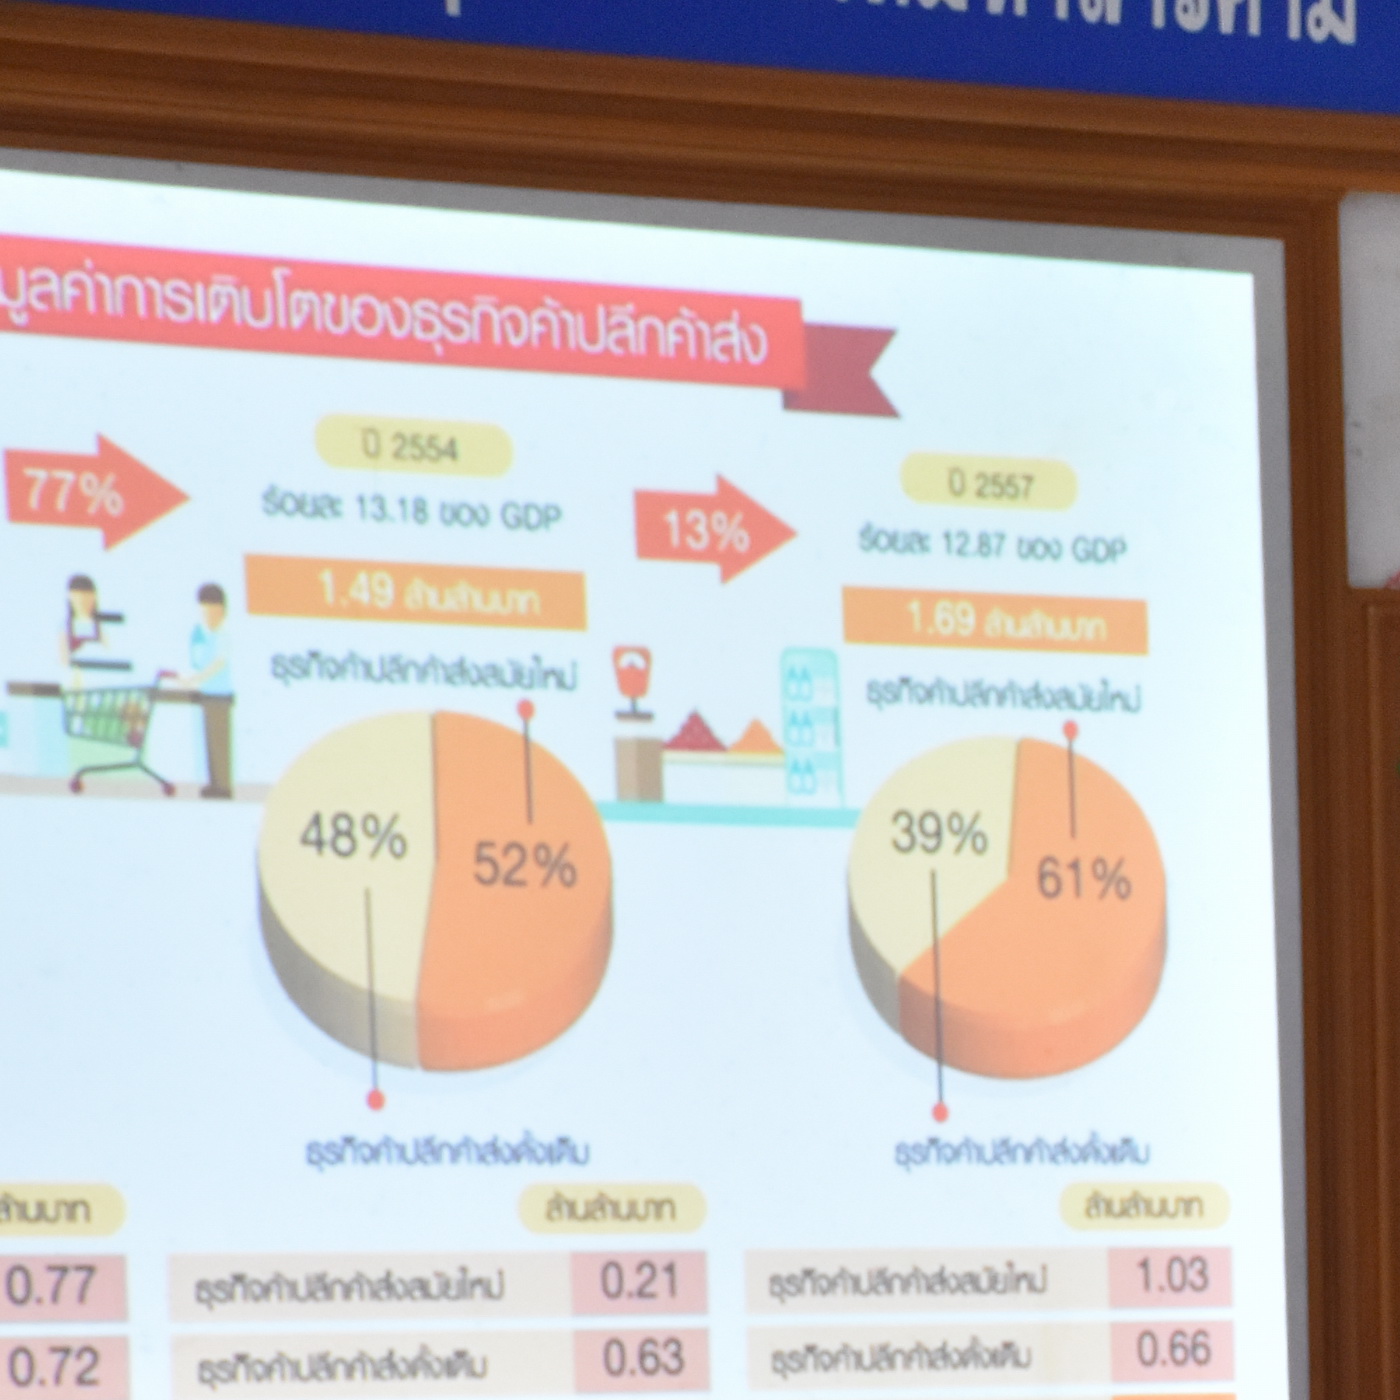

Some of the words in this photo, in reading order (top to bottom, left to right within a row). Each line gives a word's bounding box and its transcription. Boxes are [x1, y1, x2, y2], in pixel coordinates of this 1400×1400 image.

[0, 257, 769, 365] มูลค่าการเติบโตของธุรกิจค้าปลีกค้าส่ง
[361, 426, 383, 460] ปี
[392, 433, 459, 463] 2554
[22, 466, 124, 517] 77%
[947, 465, 967, 497] ปี
[974, 471, 1035, 501] 2557
[262, 484, 343, 519] ร้อยละ
[356, 495, 428, 526] 13.18
[439, 502, 490, 528] ของ
[500, 502, 563, 531] GDP
[664, 508, 750, 552] 13%
[859, 523, 931, 554] ร้อยละ
[943, 530, 1006, 558] 12.87
[1017, 538, 1062, 561] ของ
[1071, 536, 1127, 564] GDP
[320, 568, 394, 609] 1.49
[404, 577, 542, 615] ล้านล้านบาท
[908, 600, 976, 637] 1.69
[984, 609, 1107, 642] ล้านล้านบาท
[299, 811, 407, 860] 48%
[891, 809, 989, 856] 39%
[474, 841, 578, 888] 52%
[1036, 855, 1132, 901] 61%
[546, 1191, 676, 1223] ล้านล้านบาท
[1085, 1189, 1204, 1220] ล้านล้านบาท
[4, 1264, 97, 1306] 0.77
[195, 1265, 505, 1311] ธุรกิจค้าปลีกค้าส่งสมัยใหม่
[601, 1260, 677, 1300] 0.21
[769, 1260, 1048, 1304] ธุรกิจค้าปลีกค้าส่งสมัยใหม่
[1137, 1255, 1209, 1293] 1.03
[8, 1346, 100, 1388] 0.72
[198, 1343, 488, 1390] ธุรกิจค้าปลีกค้าส่งดั้งเดิม
[603, 1336, 685, 1377] 0.63
[771, 1335, 1031, 1378] ธุรกิจค้าปลีกค้าส่งดั้งเดิม
[1136, 1328, 1212, 1368] 0.66
